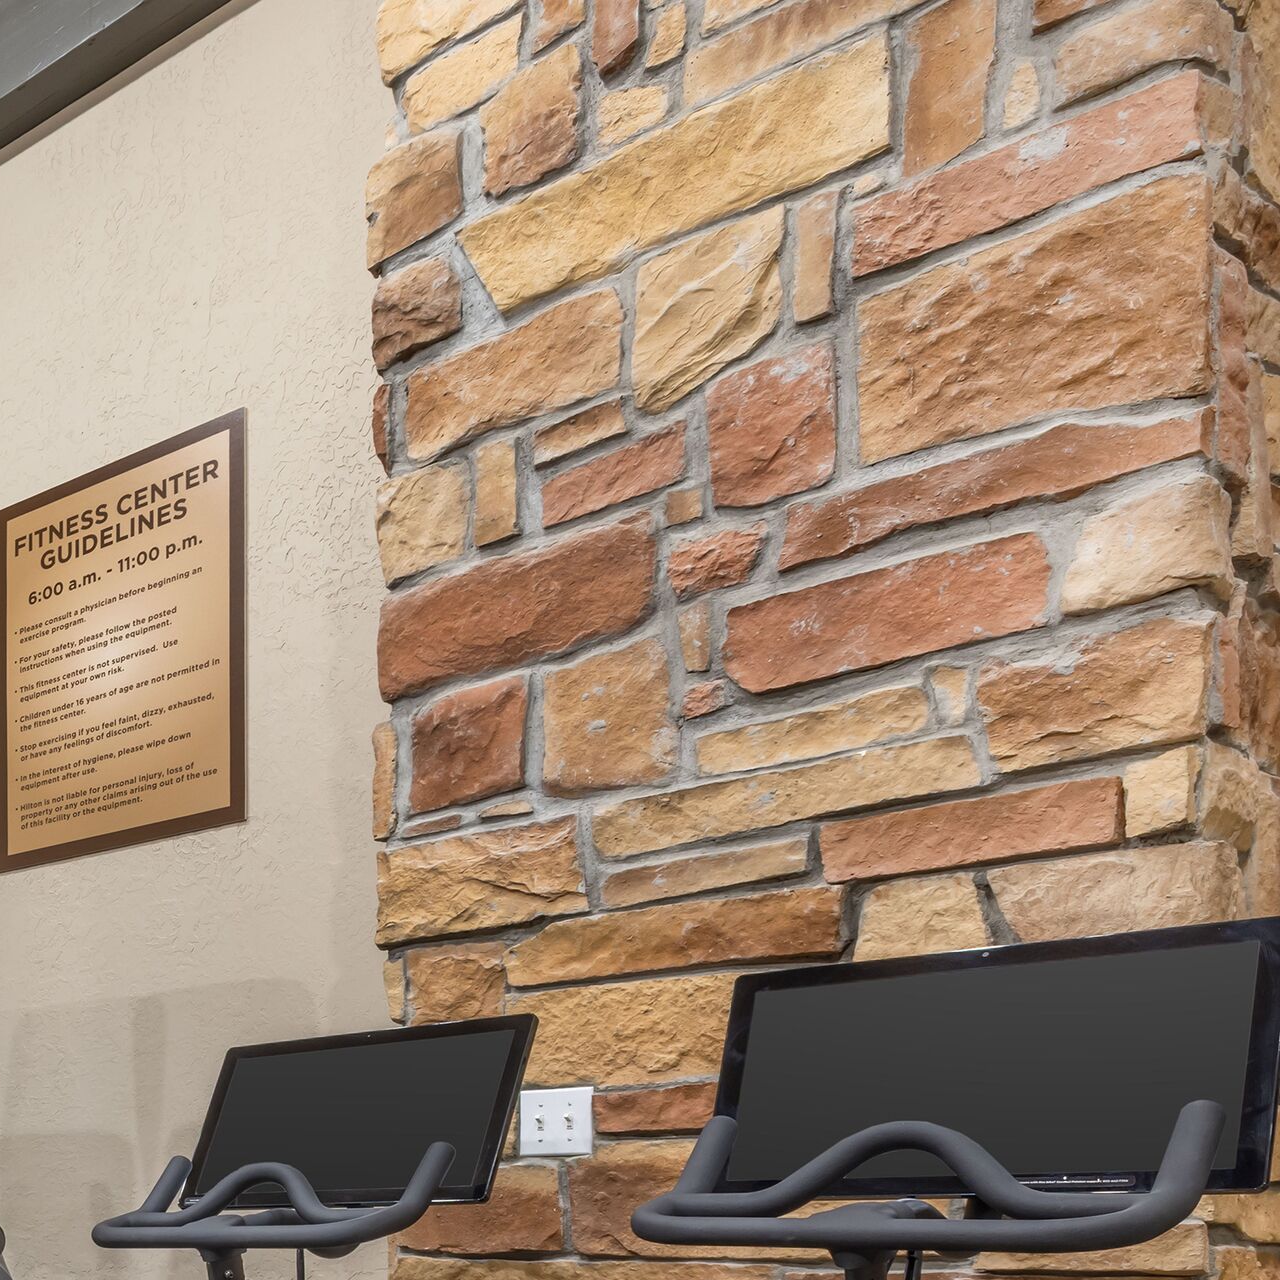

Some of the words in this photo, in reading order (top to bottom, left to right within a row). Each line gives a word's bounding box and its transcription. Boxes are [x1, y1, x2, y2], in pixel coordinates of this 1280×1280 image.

[14, 503, 109, 558] FITNESS
[116, 459, 219, 516] CENTER
[40, 497, 188, 570] GUIDELINES
[28, 581, 64, 606] 6:00
[68, 571, 102, 592] a.m.
[117, 546, 160, 573] 11:00
[165, 534, 203, 560] p.m.
[19, 622, 44, 635] Please
[44, 610, 73, 627] consult
[73, 609, 79, 617] a
[79, 596, 117, 616] physician
[118, 586, 146, 601] before
[147, 570, 190, 591] beginning
[191, 566, 203, 576] an
[19, 628, 50, 645] exercise
[50, 617, 87, 635] program.
[19, 655, 33, 665] For
[32, 649, 51, 661] your
[51, 640, 78, 654] safety,
[78, 631, 104, 647] please
[105, 622, 131, 636] follow
[132, 617, 146, 627] the
[147, 605, 178, 624] posted
[19, 654, 64, 674] instructions
[64, 647, 86, 659] when
[86, 639, 109, 652] using
[109, 635, 124, 645] the
[124, 618, 173, 640] equipment.
[19, 683, 35, 694] This
[35, 675, 61, 689] fitness
[61, 667, 87, 681] center
[88, 664, 95, 673] is
[96, 659, 110, 670] not
[111, 644, 159, 665] supervised.
[162, 639, 179, 649] Use
[19, 685, 60, 703] equipment
[60, 681, 69, 691] at
[70, 676, 89, 689] your
[89, 671, 107, 682] own
[107, 665, 125, 676] risk.
[19, 709, 51, 724] Children
[51, 701, 75, 714] under
[75, 697, 85, 707] 16
[85, 692, 108, 705] years
[108, 687, 118, 697] of
[118, 684, 134, 694] age
[135, 679, 150, 689] are
[150, 673, 166, 685] not
[166, 659, 210, 681] permitted
[211, 658, 221, 666] in
[19, 724, 33, 733] the
[33, 716, 59, 729] fitness
[59, 708, 87, 721] center.
[19, 743, 38, 753] Stop
[38, 731, 77, 748] exercising
[78, 727, 85, 737] if
[85, 724, 101, 736] you
[101, 718, 117, 731] feel
[118, 713, 140, 726] faint,
[141, 707, 166, 719] dizzy,
[167, 691, 215, 712] exhausted,
[20, 754, 29, 762] or
[29, 749, 48, 760] have
[48, 745, 63, 755] any
[63, 734, 96, 751] feelings
[95, 731, 105, 742] of
[105, 719, 153, 739] discomfort.
[20, 775, 61, 792] equipment
[61, 768, 81, 782] after
[81, 766, 98, 776] use.
[28, 771, 41, 780] the
[42, 762, 72, 777] interest
[72, 759, 82, 769] of
[82, 752, 117, 766] hygiene,
[117, 744, 145, 759] please
[145, 738, 166, 749] wipe
[167, 731, 192, 744] down
[20, 801, 43, 812] Hilton
[43, 798, 51, 806] is
[51, 794, 65, 804] not
[65, 789, 88, 801] liable
[88, 786, 101, 795] for
[101, 775, 137, 793] personal
[138, 771, 165, 783] injury,
[166, 765, 184, 776] loss
[184, 761, 195, 772] of
[20, 807, 54, 823] property
[54, 805, 64, 813] or
[63, 801, 79, 811] any
[79, 795, 101, 807] other
[102, 789, 128, 802] claims
[129, 782, 158, 795] arising
[158, 777, 174, 788] out
[175, 773, 185, 784] of
[186, 772, 201, 781] the
[202, 768, 218, 777] use
[20, 821, 29, 831] of
[29, 819, 44, 829] this
[44, 813, 72, 825] facility
[71, 808, 82, 818] or
[82, 807, 96, 816] the
[96, 795, 143, 813] equipment.
